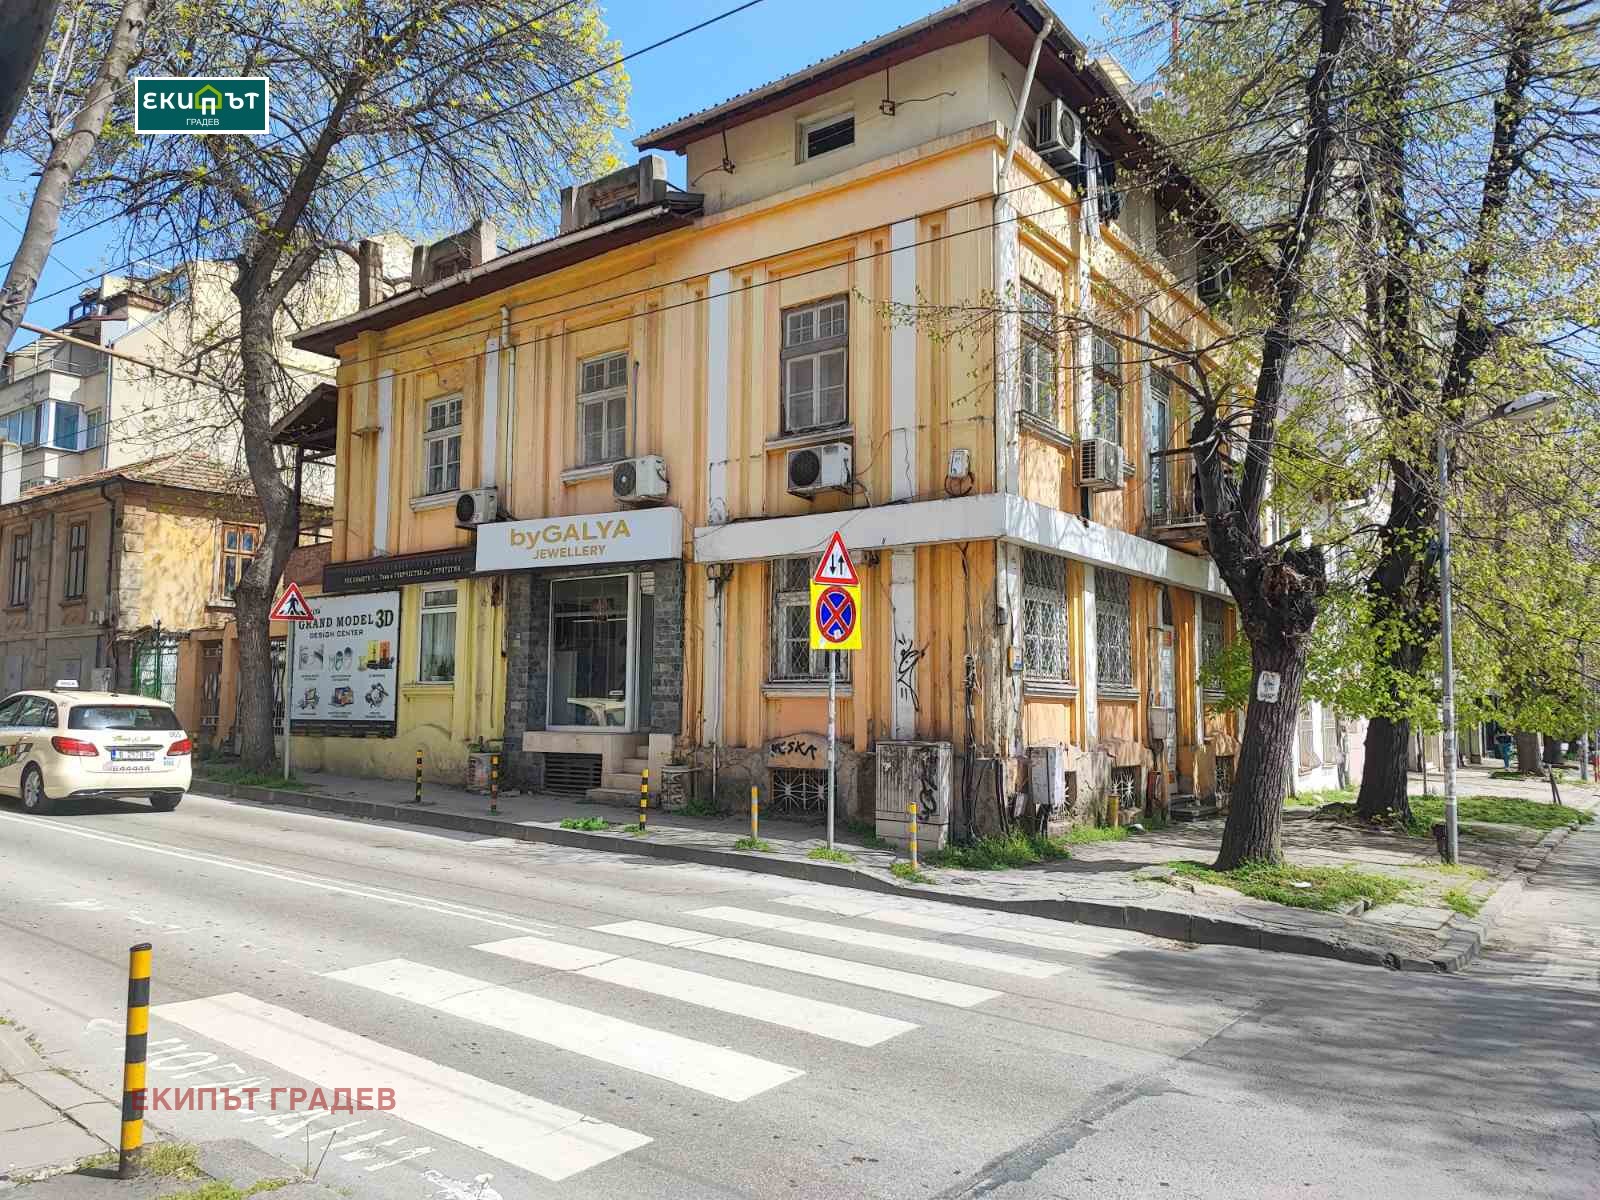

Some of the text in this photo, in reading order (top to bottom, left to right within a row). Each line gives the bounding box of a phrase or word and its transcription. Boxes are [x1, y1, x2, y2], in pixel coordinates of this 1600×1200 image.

[510, 519, 631, 549] byGALYA
[533, 545, 606, 560] JEWELLERY
[299, 609, 394, 630] GRAND MODEL 3D
[309, 629, 364, 639] DESIGN CENTER
